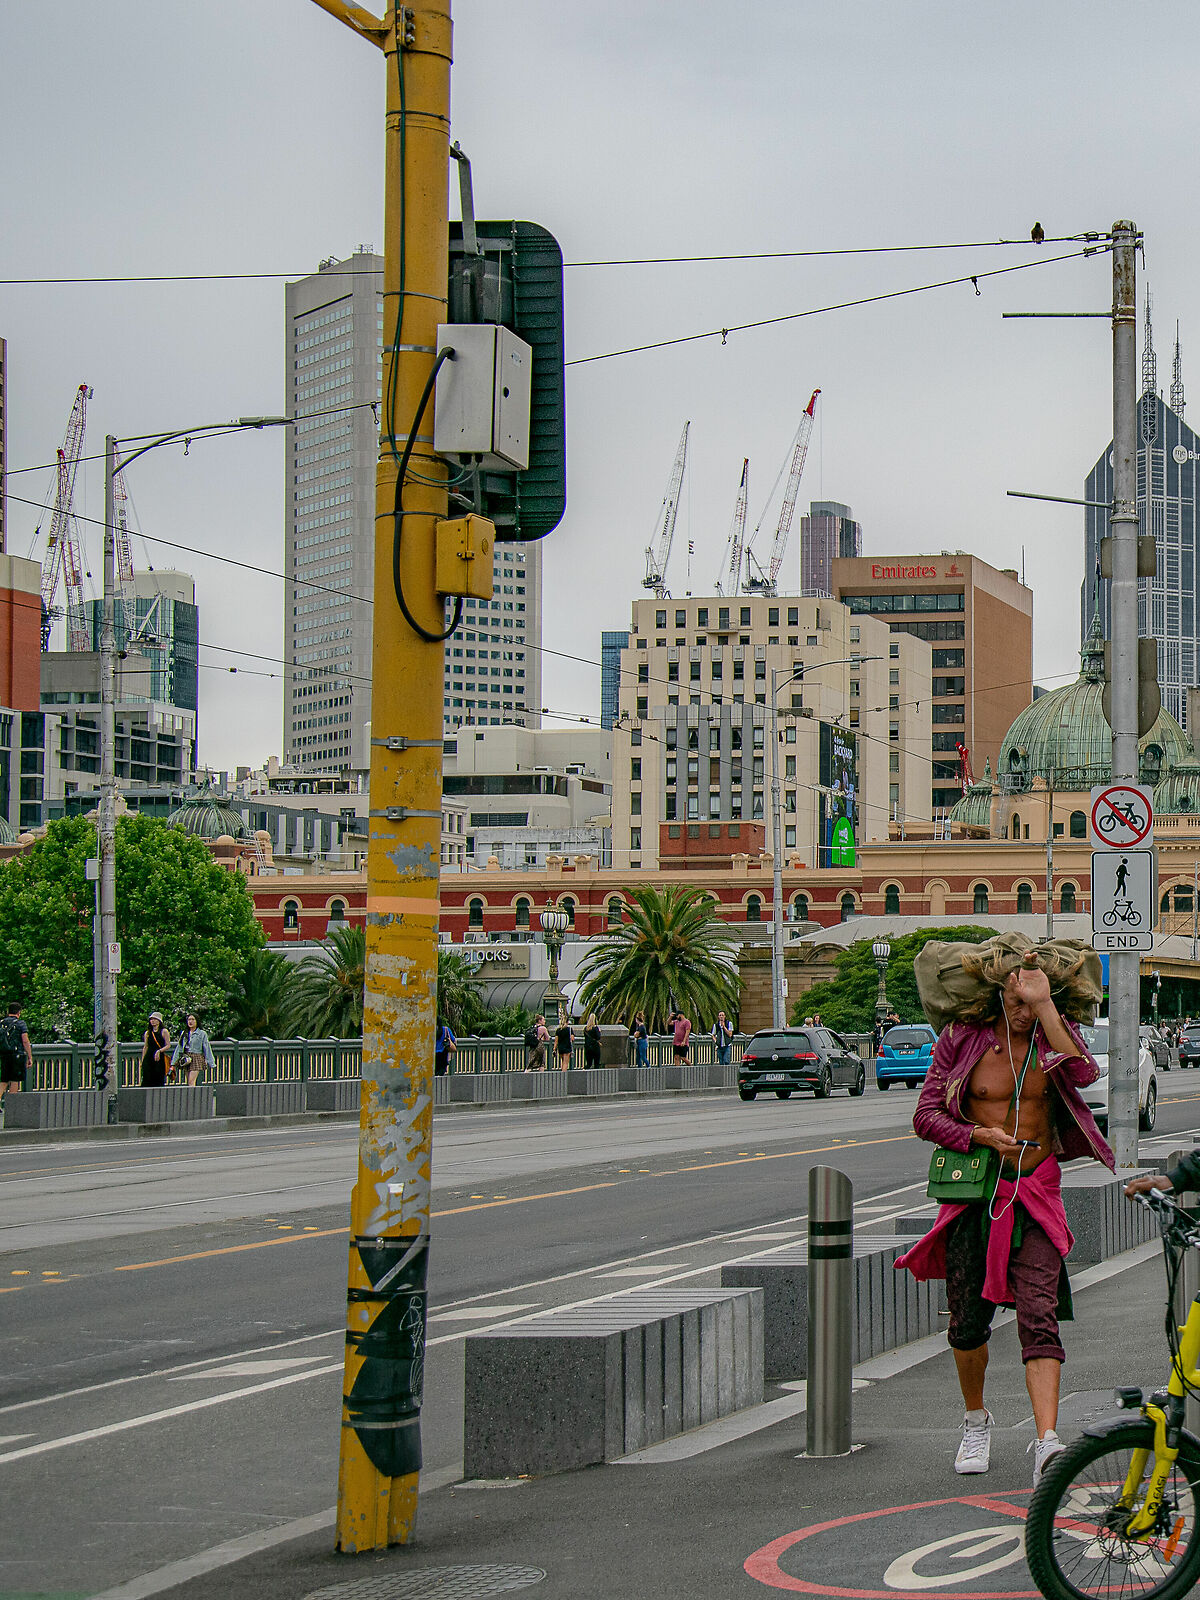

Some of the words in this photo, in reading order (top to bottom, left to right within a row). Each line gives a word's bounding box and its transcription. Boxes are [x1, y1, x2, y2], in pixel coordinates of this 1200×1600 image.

[871, 563, 937, 579] Emirates
[1106, 936, 1138, 947] END
[1153, 1475, 1167, 1499] EASI
